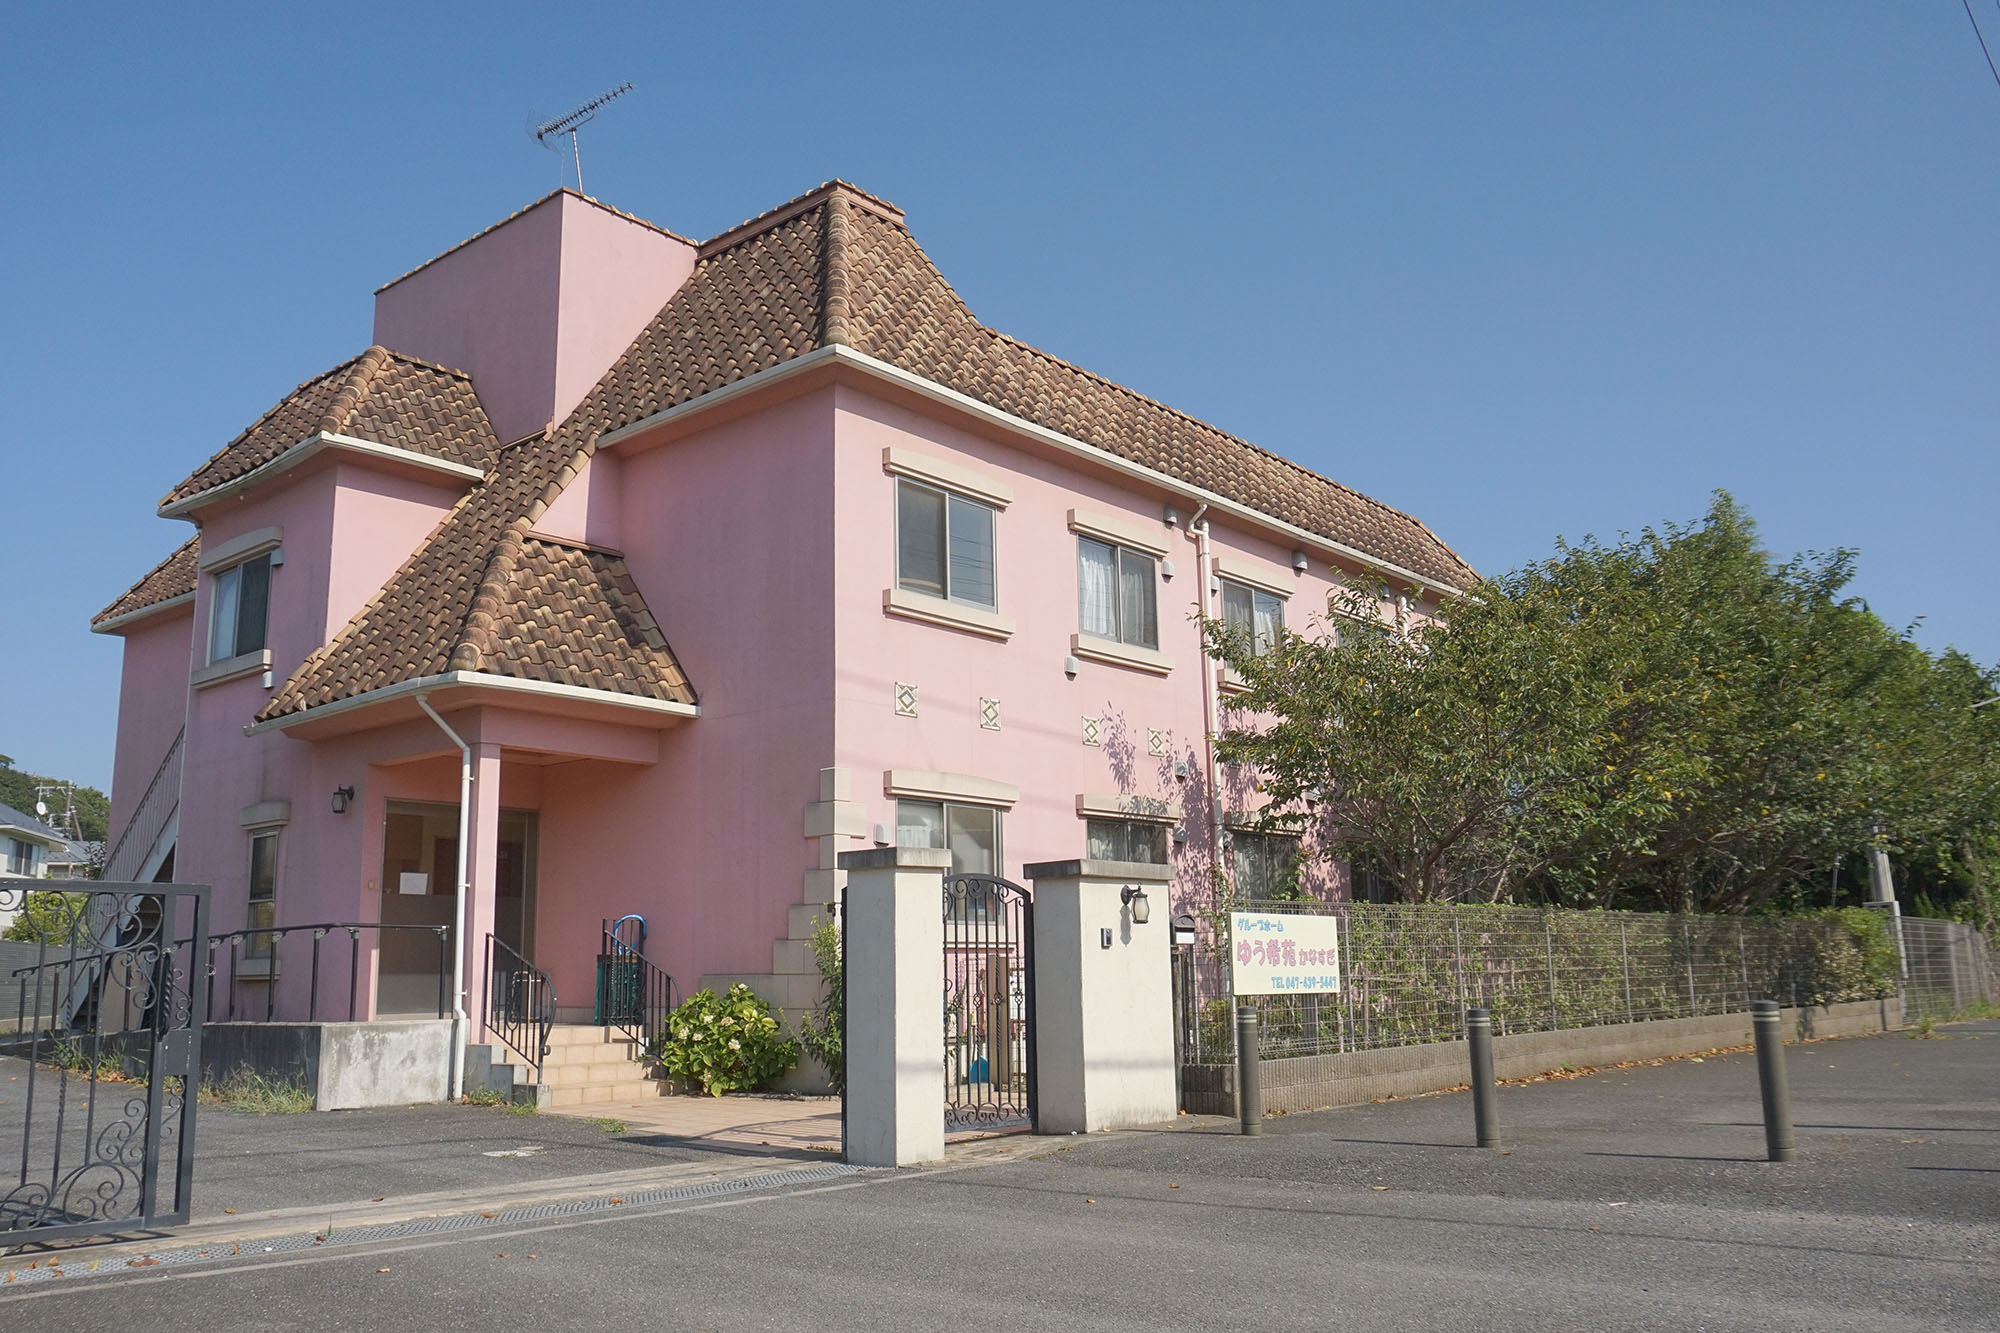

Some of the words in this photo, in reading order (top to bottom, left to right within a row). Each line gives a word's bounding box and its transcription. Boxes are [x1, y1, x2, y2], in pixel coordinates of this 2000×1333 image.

[1238, 918, 1284, 932] グループホーム
[1299, 948, 1336, 966] かなすぎ
[1271, 976, 1284, 989] TEL
